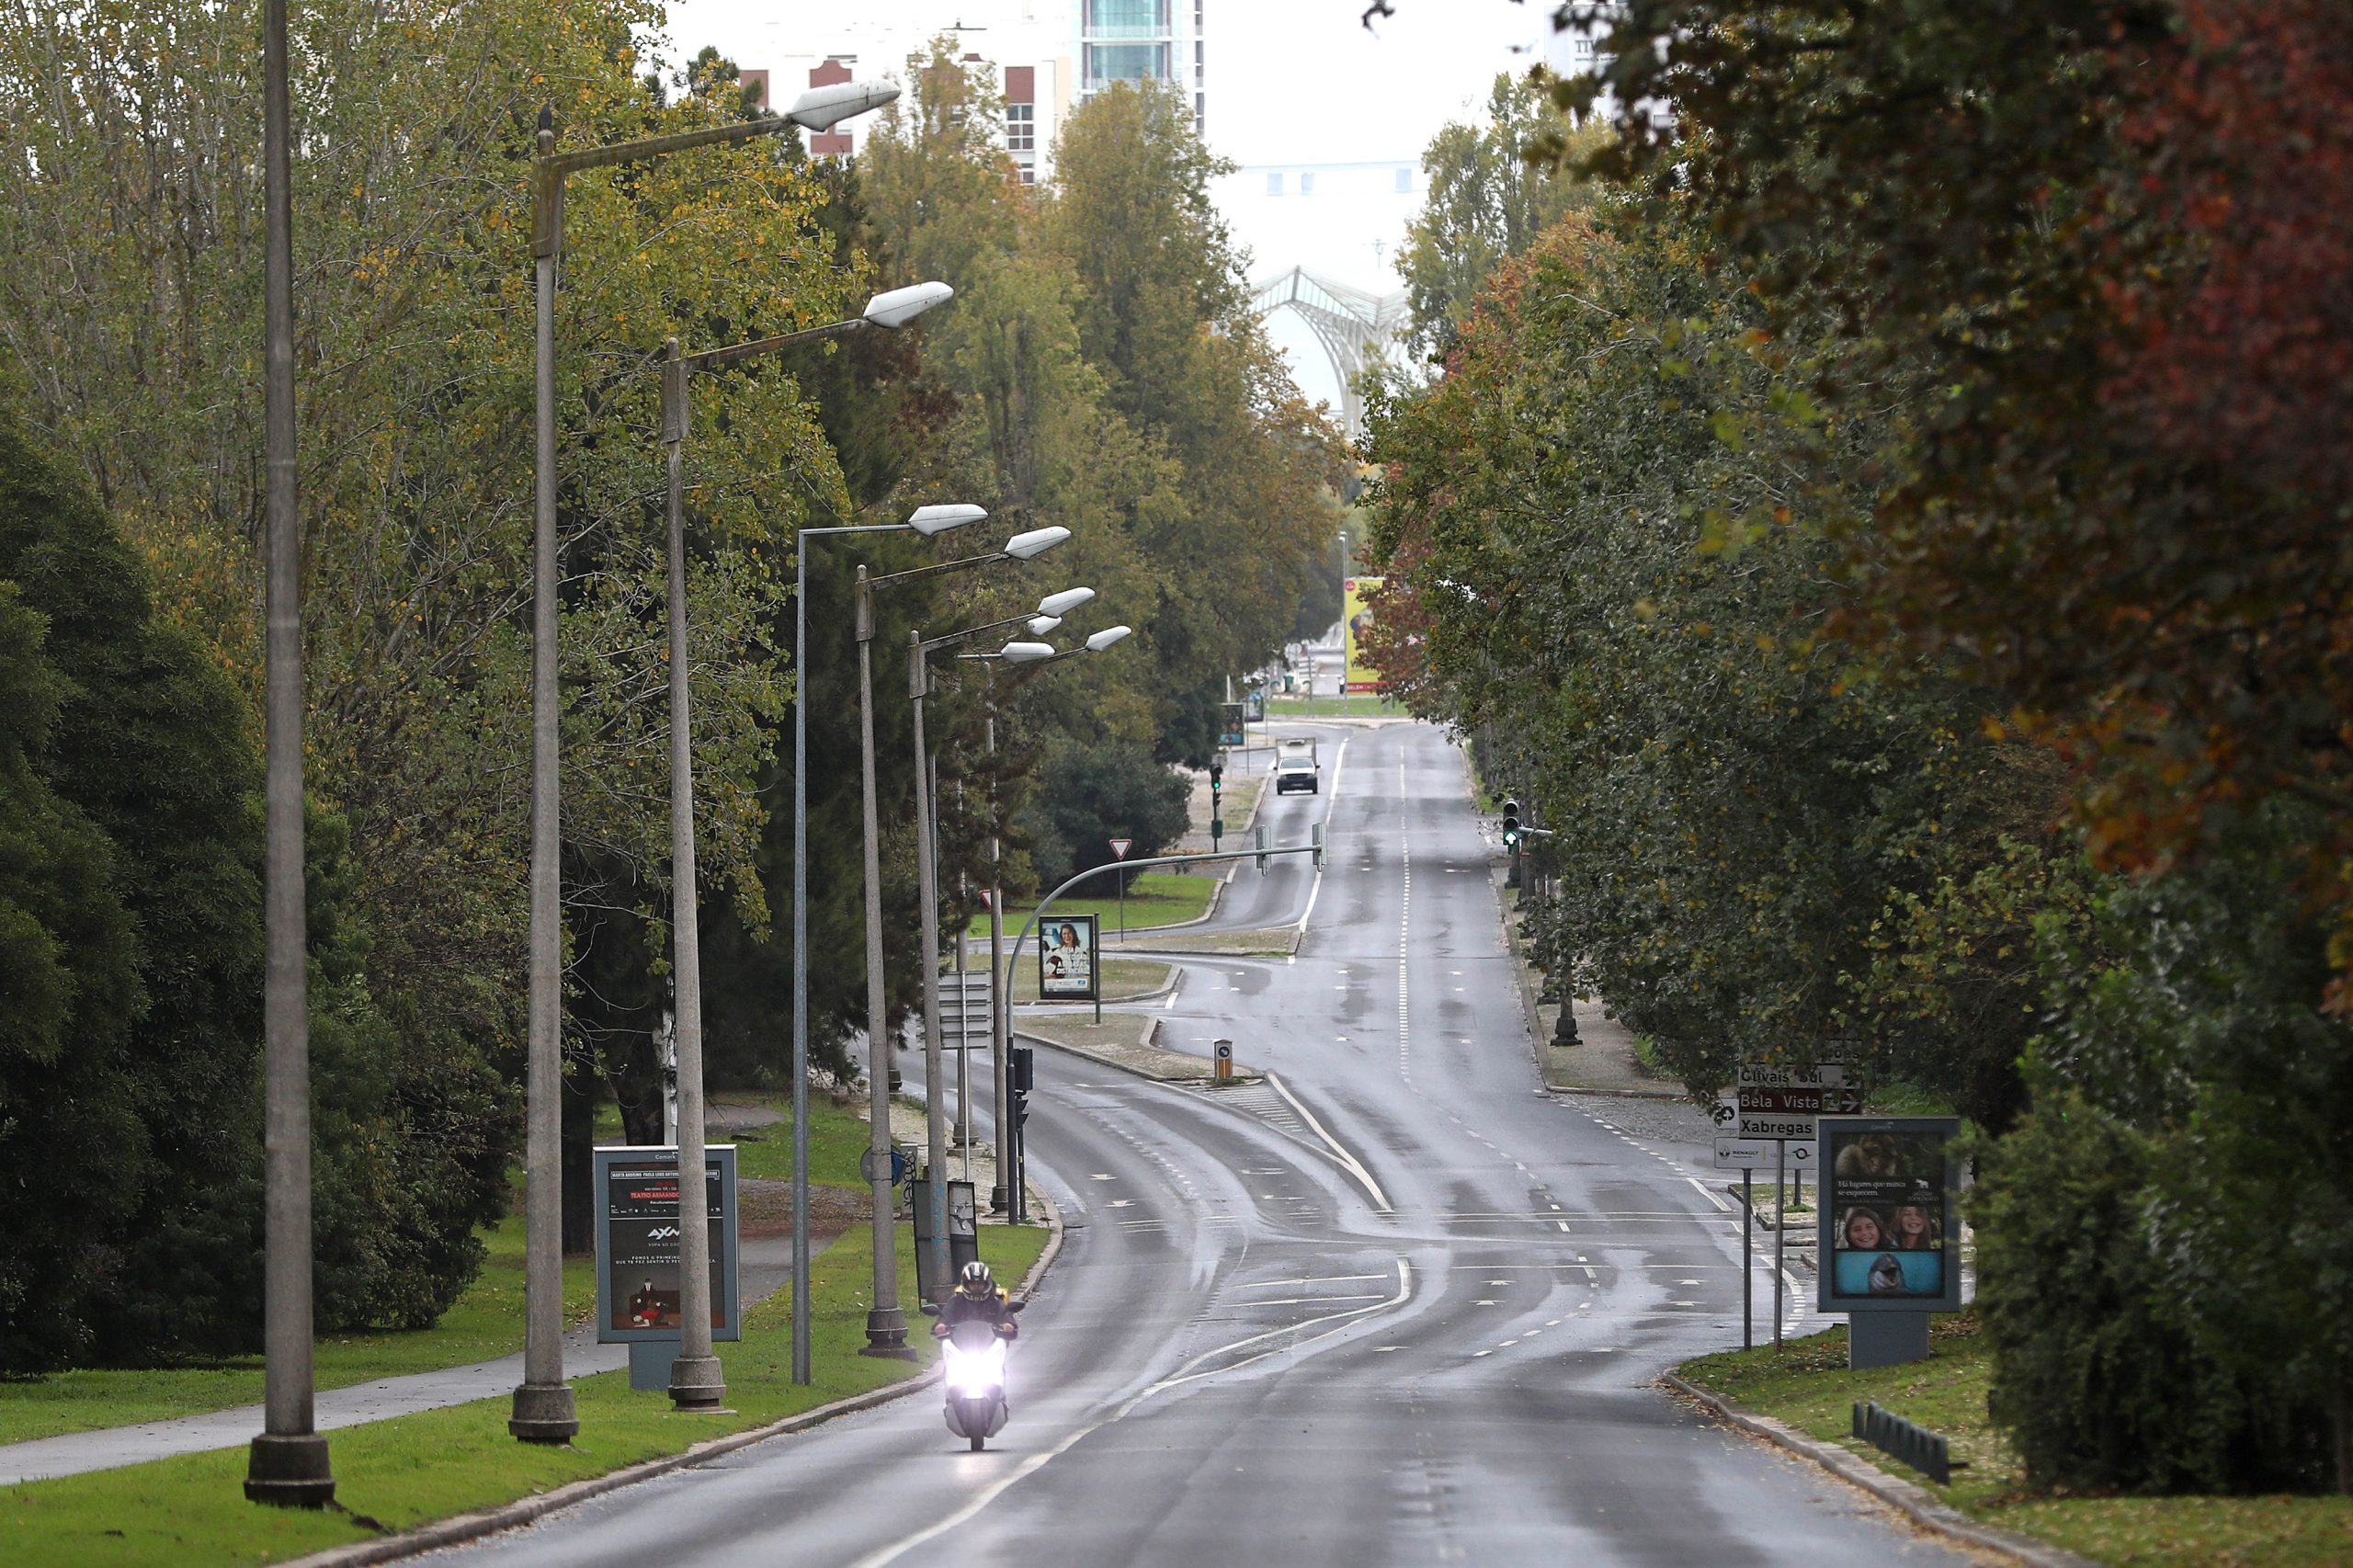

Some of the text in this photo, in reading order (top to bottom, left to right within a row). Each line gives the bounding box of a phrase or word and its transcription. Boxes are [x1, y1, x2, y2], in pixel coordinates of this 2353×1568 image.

[1740, 1094, 1819, 1108] Bela Vista
[1741, 1119, 1813, 1135] Xabregas
